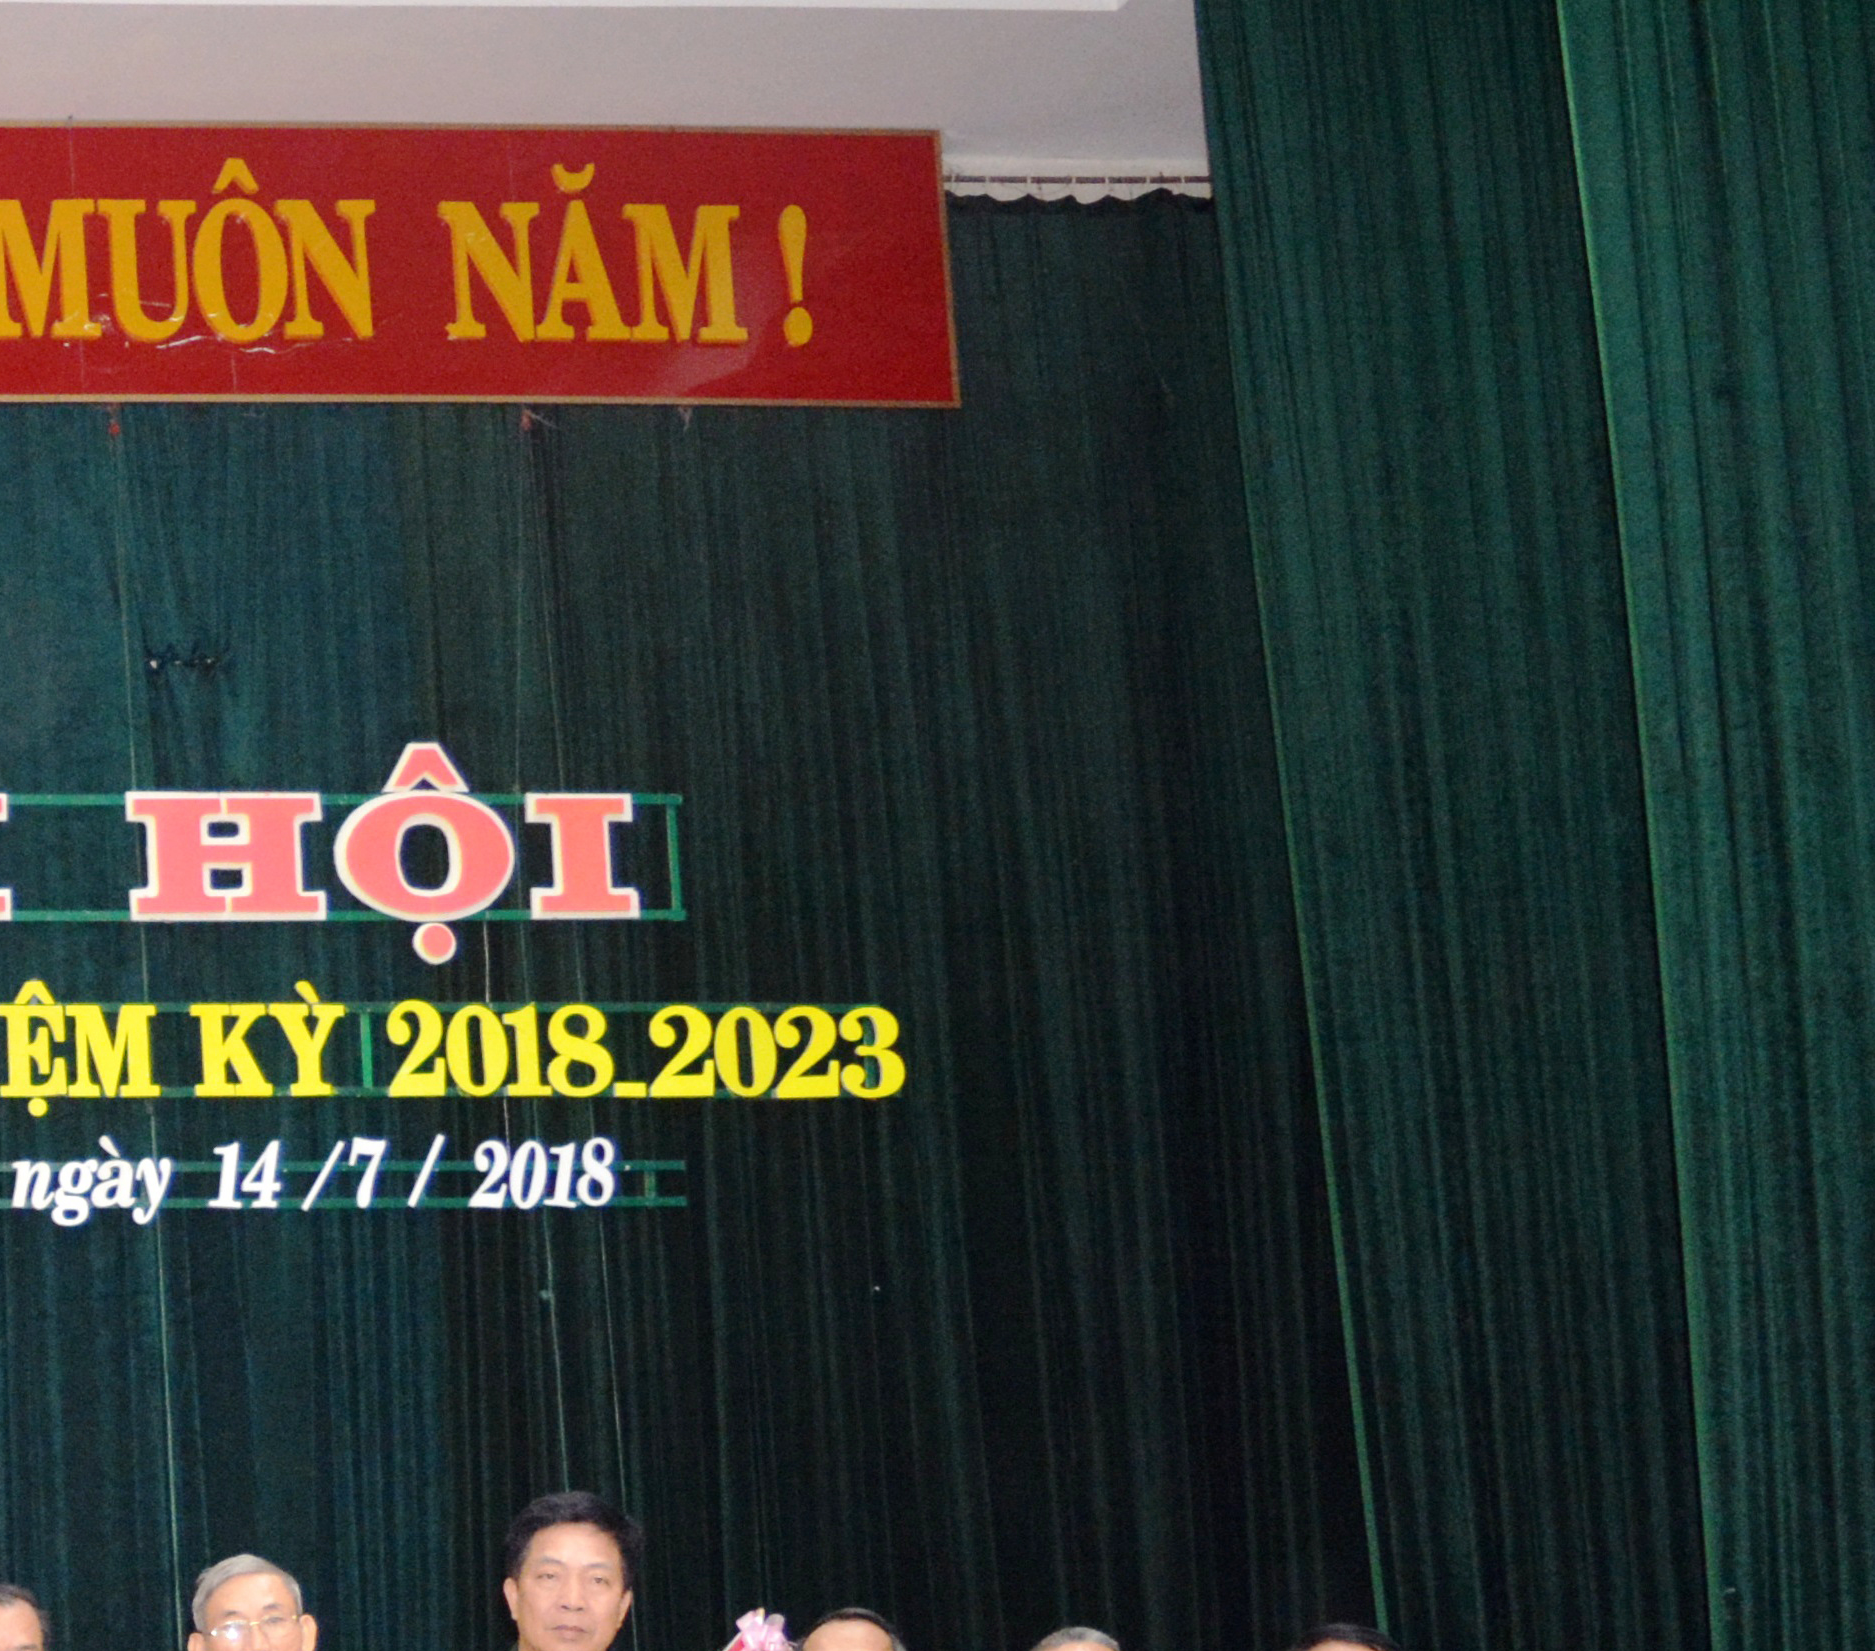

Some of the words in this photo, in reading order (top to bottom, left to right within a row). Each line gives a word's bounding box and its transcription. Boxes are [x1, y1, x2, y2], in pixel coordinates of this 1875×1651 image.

[439, 164, 748, 344] NĂM
[125, 742, 640, 965] HỘI
[193, 980, 341, 1098] KỲ
[11, 1135, 172, 1226] ngày
